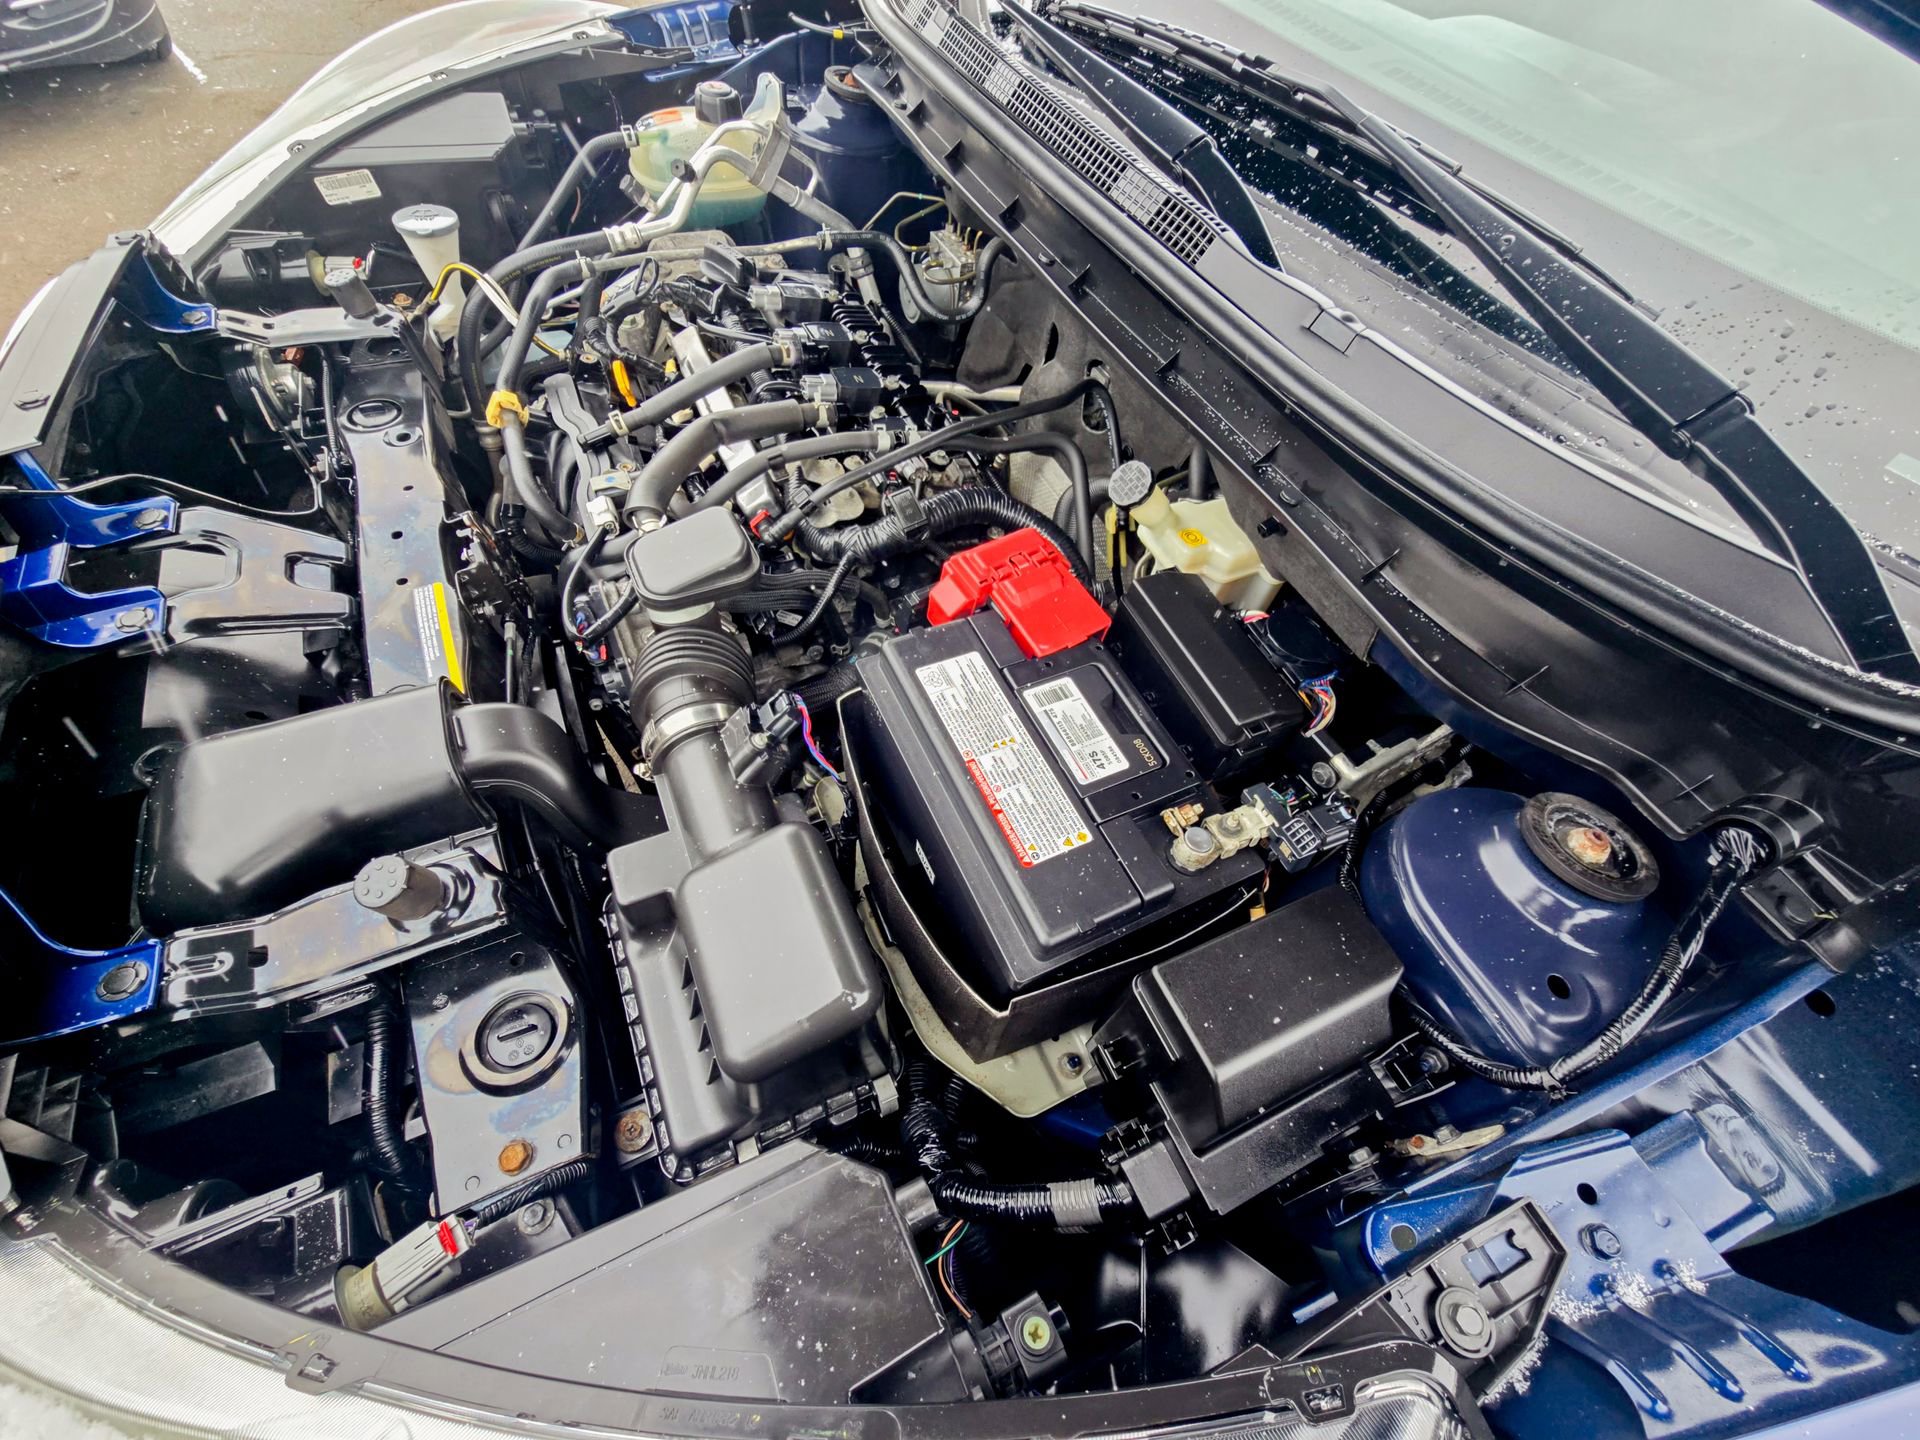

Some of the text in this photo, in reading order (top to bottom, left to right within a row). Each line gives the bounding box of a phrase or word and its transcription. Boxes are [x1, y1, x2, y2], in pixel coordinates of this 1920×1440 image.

[1087, 749, 1106, 772] 47S
[1132, 737, 1157, 767] 5CKD08
[968, 760, 997, 805] PELIGRO/VENENO
[996, 812, 1026, 857] DANGER/POISON
